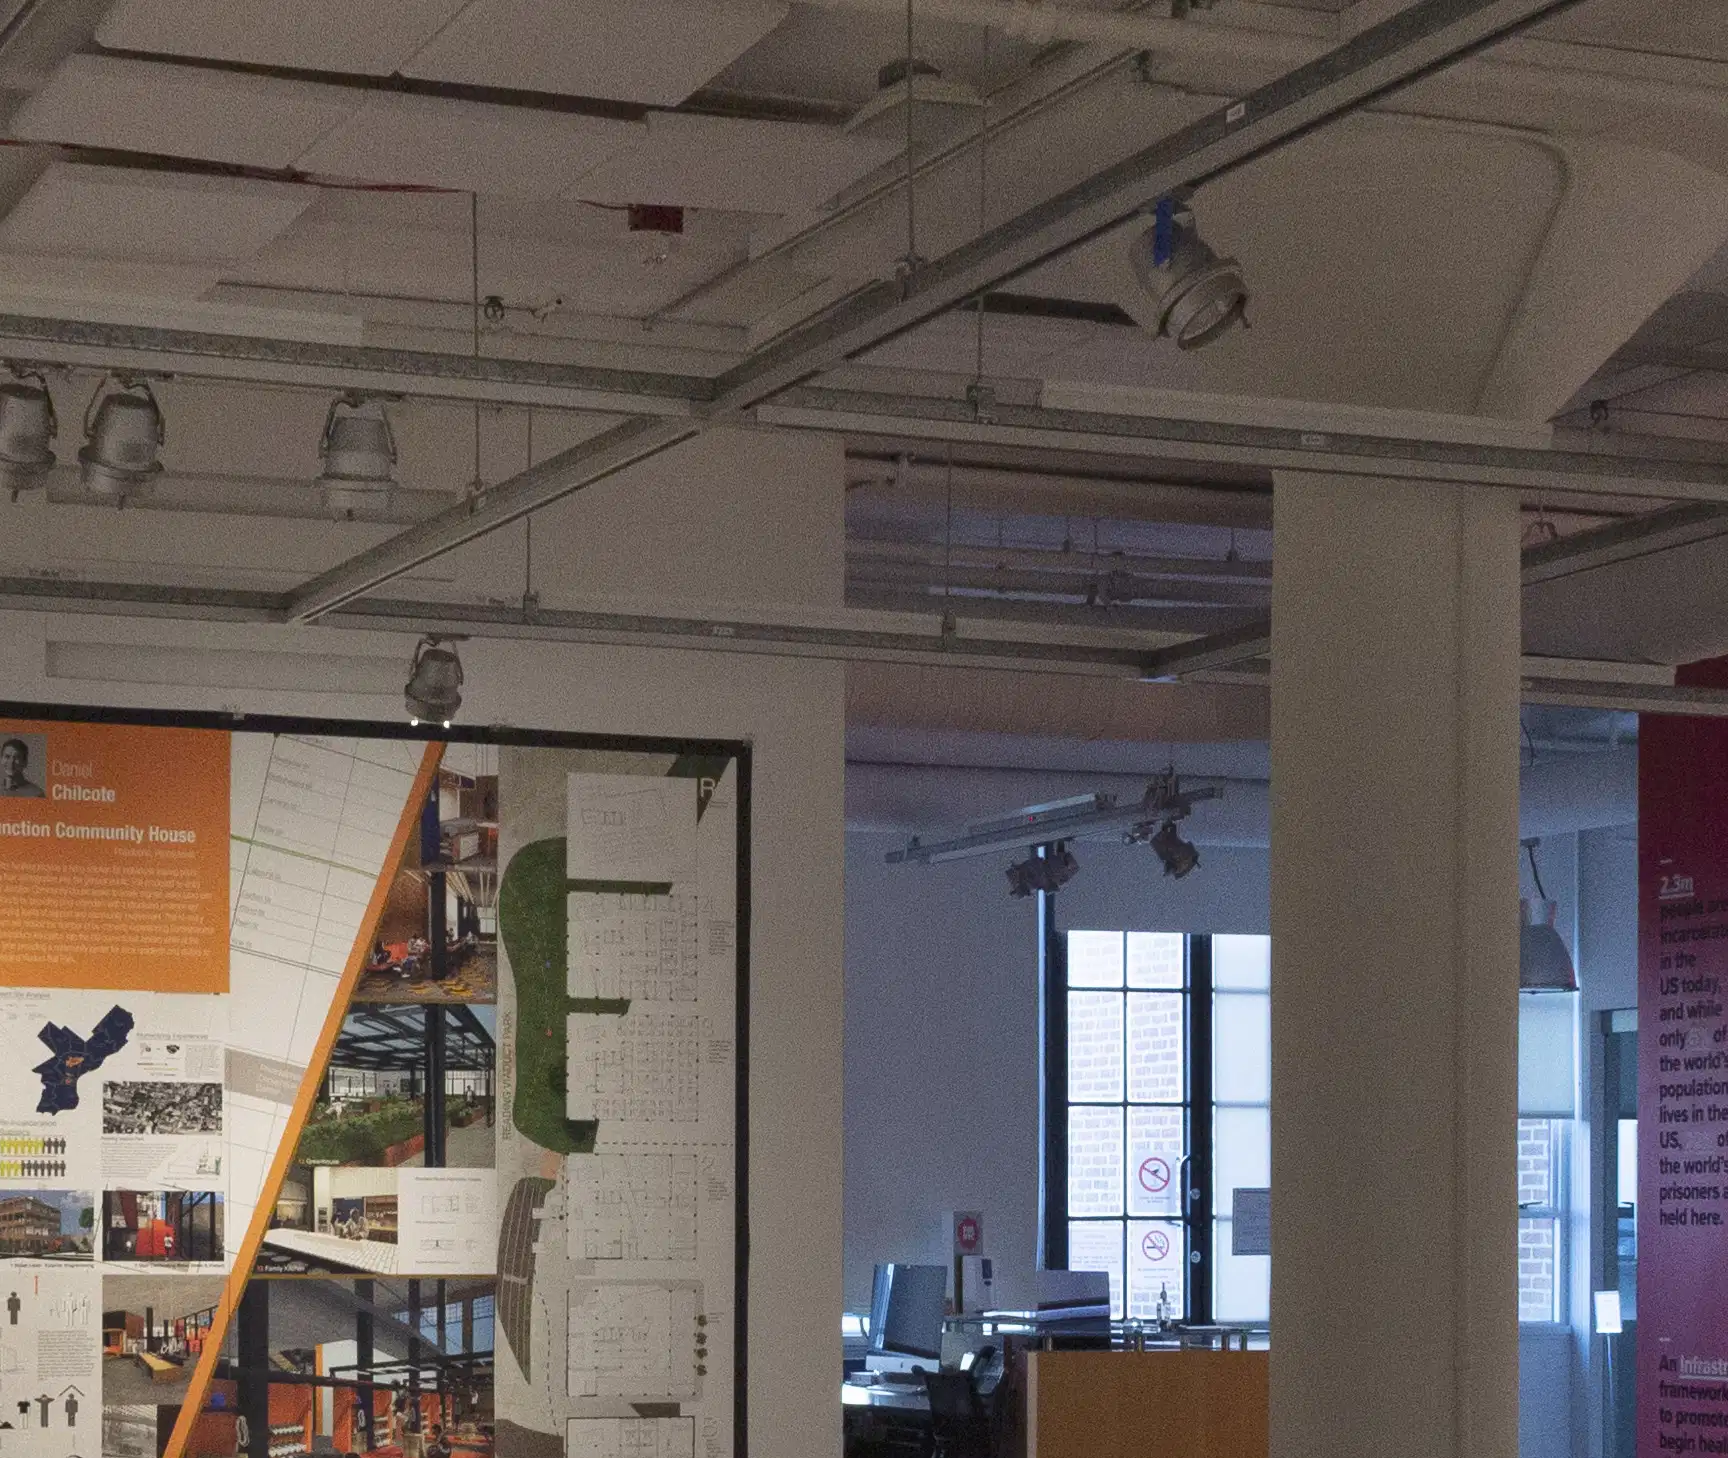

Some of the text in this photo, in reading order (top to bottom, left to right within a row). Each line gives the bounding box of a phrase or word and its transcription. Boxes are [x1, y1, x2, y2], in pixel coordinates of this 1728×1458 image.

[52, 760, 93, 778] Daniel
[52, 785, 116, 802] Chilcote
[56, 823, 144, 843] Community
[149, 826, 195, 843] House
[502, 1011, 512, 1141] READING VIADUCT PARK
